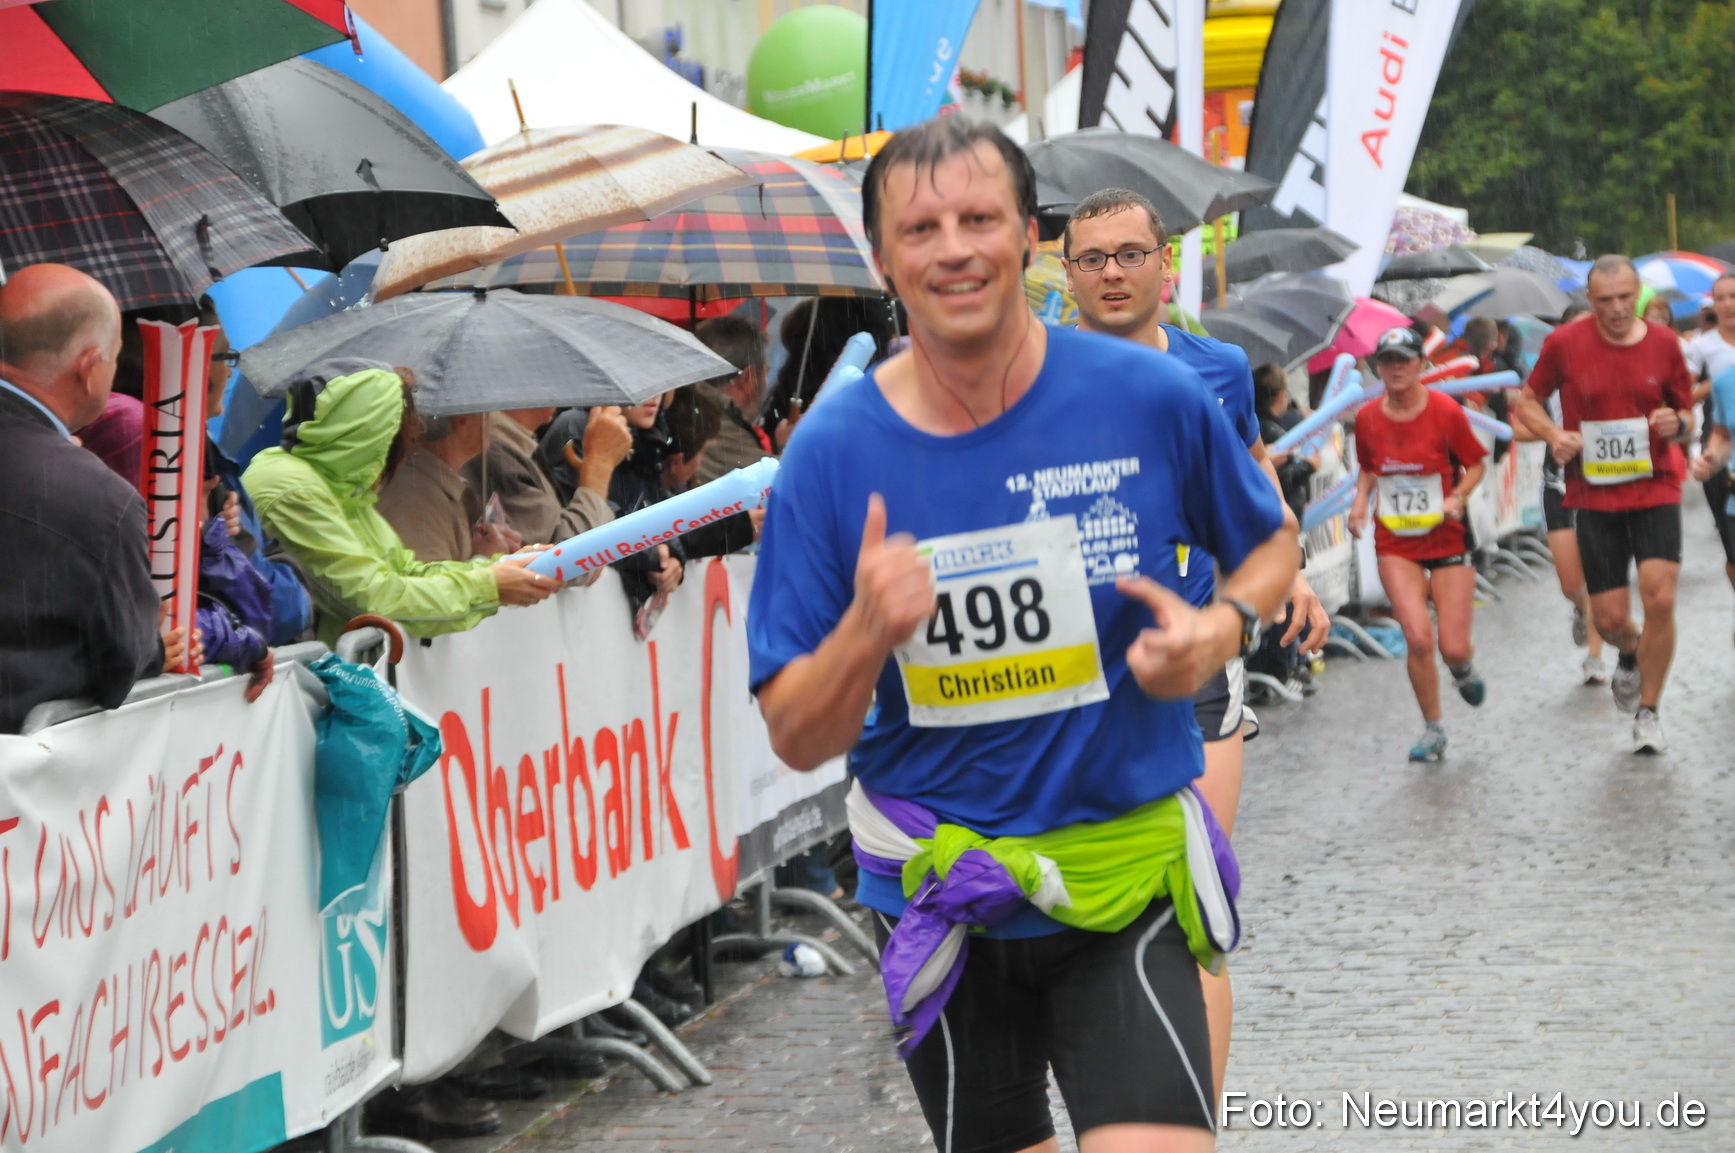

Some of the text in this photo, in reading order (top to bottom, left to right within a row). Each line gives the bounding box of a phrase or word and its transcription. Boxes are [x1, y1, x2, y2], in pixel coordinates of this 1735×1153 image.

[1361, 30, 1409, 169] Audi
[1596, 436, 1637, 460] 304
[1005, 456, 1140, 494] 12. NEUMARKTER
[1032, 474, 1121, 501] STADTLAUF
[1391, 490, 1430, 513] 173
[616, 500, 744, 556] ReiseCenter
[926, 577, 1051, 656] 498
[938, 664, 1056, 700] Christian
[439, 641, 691, 953] Oberbank
[32, 794, 116, 949] UNS
